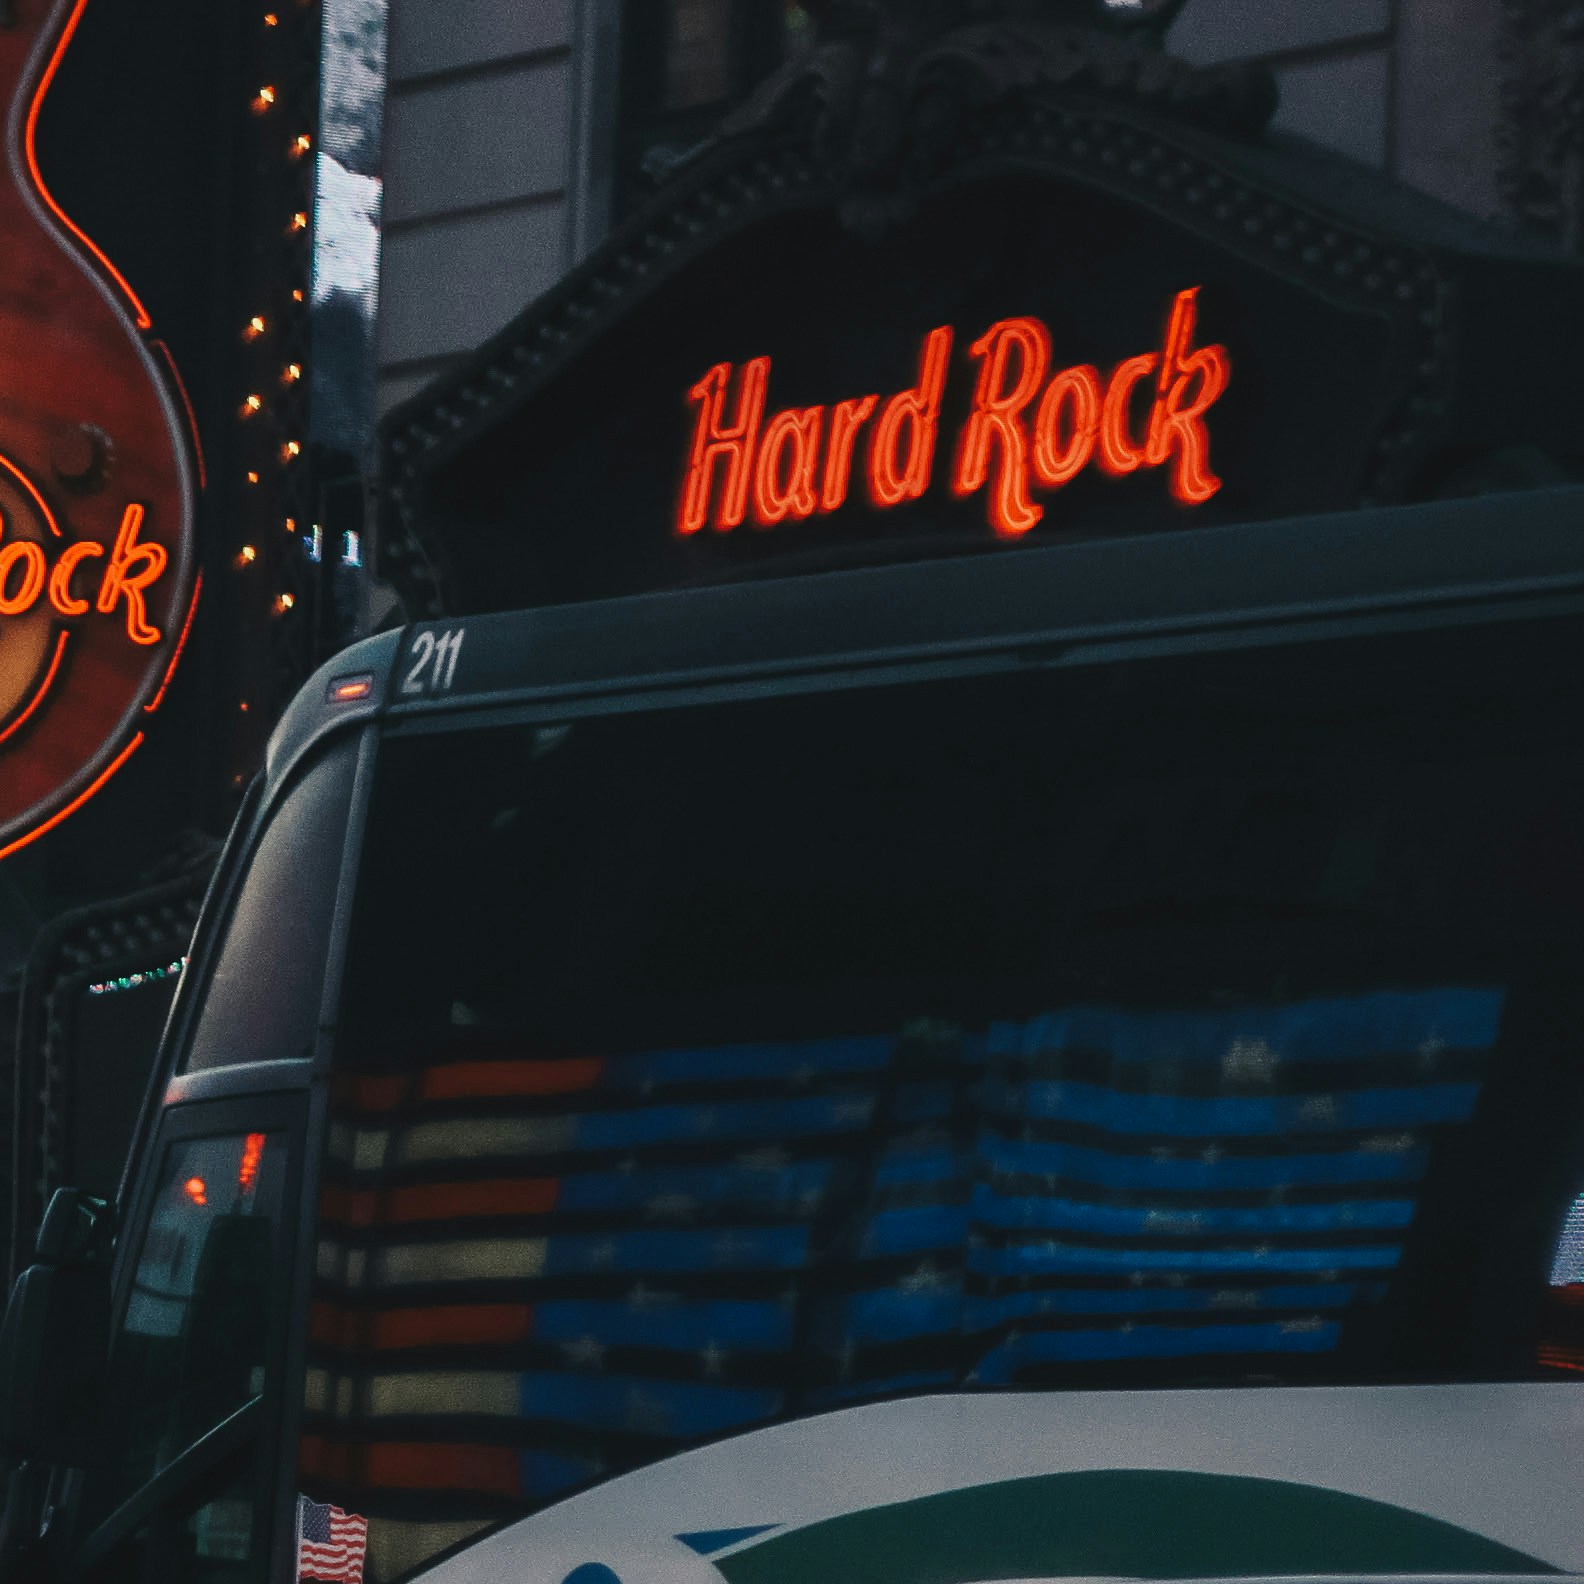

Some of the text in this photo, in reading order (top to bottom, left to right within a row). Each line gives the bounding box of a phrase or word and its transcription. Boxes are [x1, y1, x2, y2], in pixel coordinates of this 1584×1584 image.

[676, 286, 1229, 538] Hard Rock
[401, 628, 465, 694] 211
